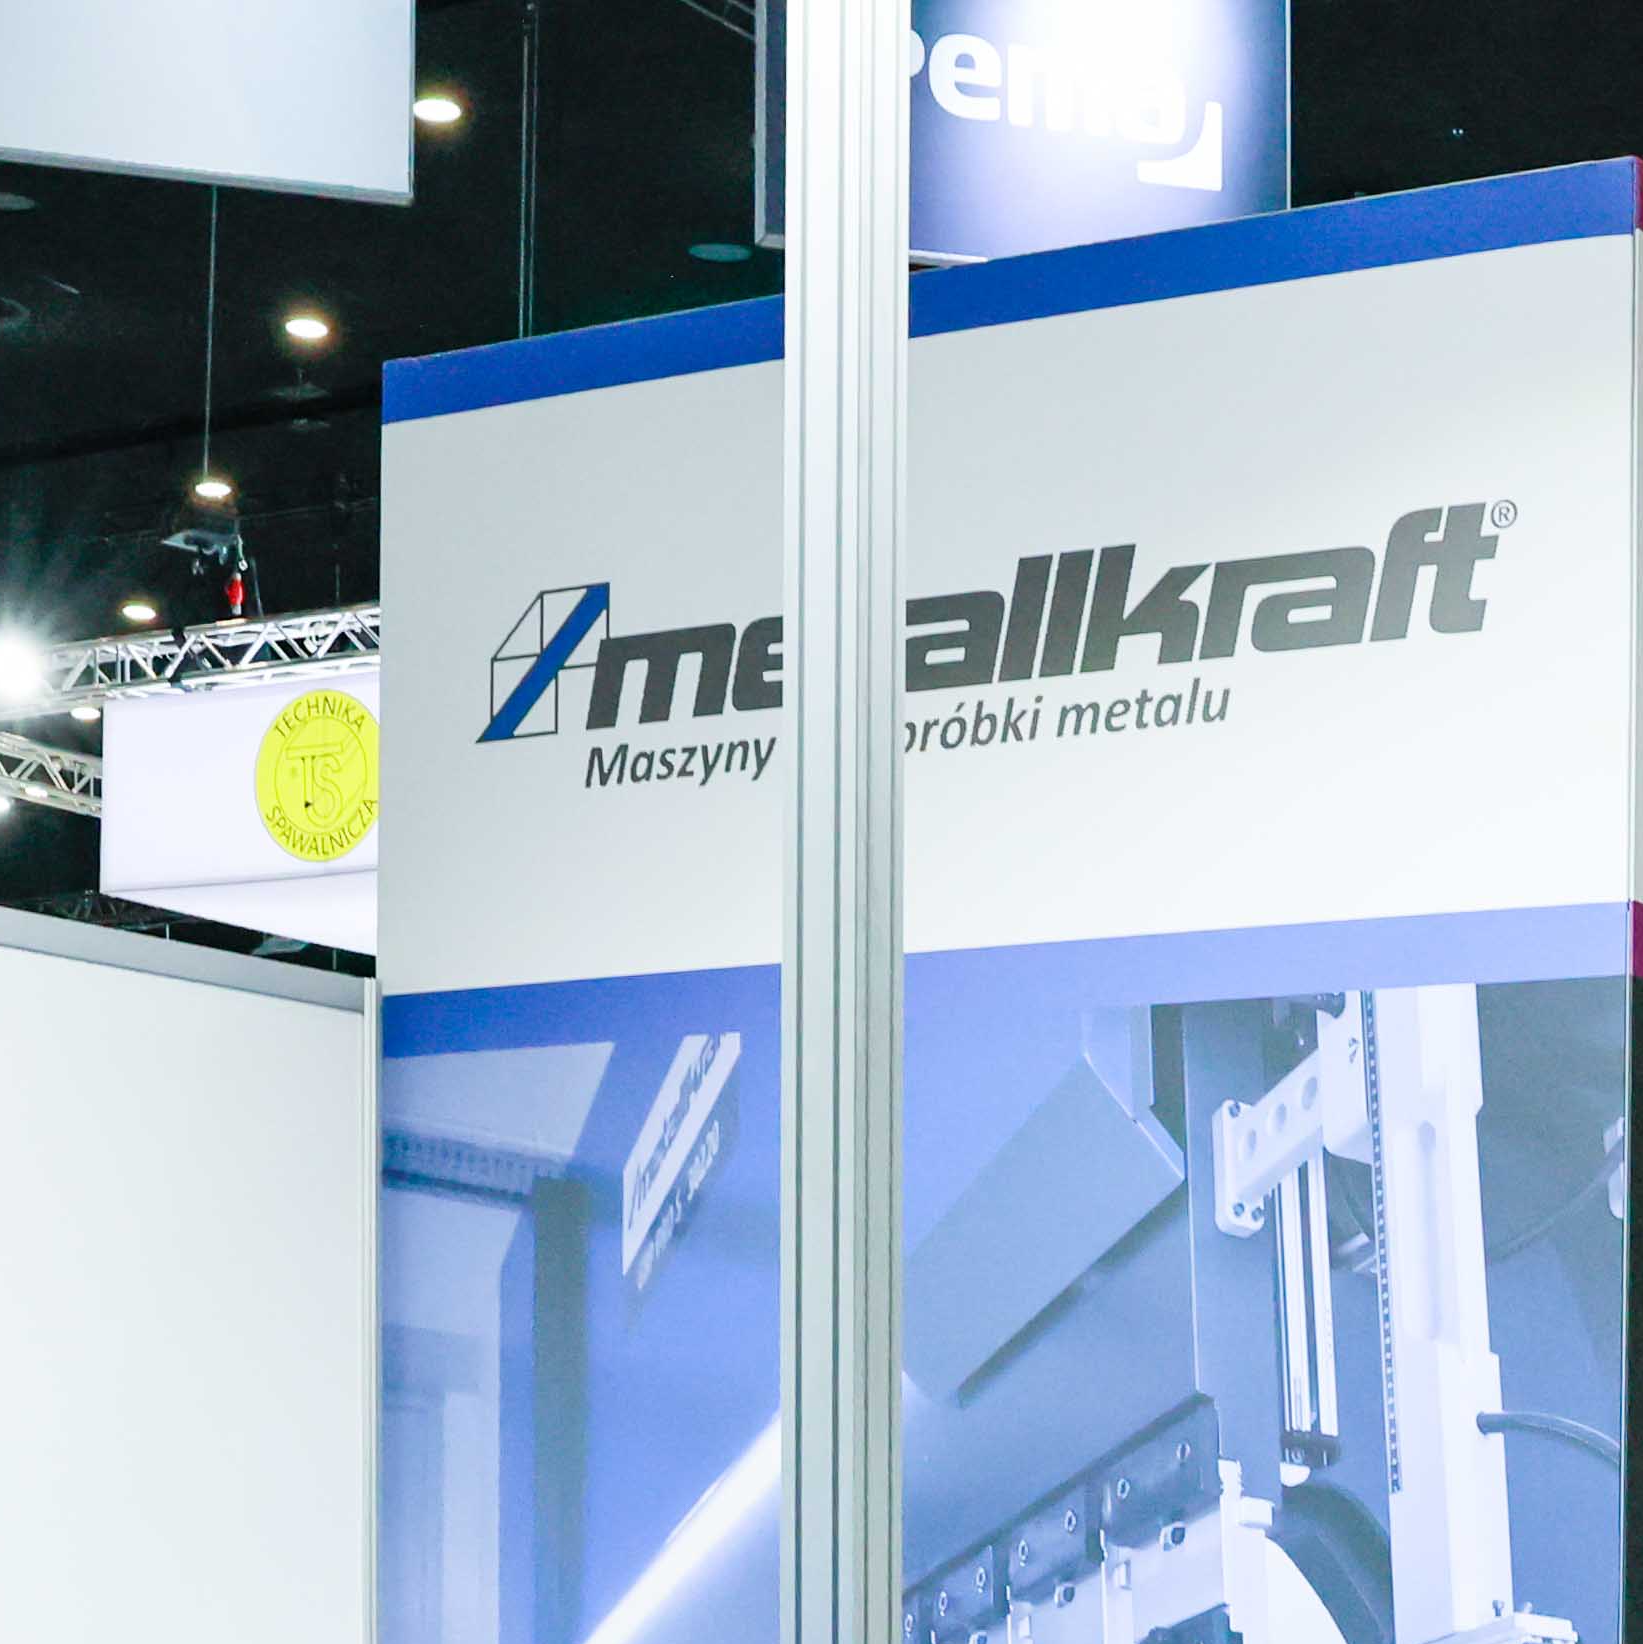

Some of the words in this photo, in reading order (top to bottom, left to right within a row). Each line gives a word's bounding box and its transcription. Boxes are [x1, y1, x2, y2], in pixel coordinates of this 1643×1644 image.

[586, 502, 1502, 729] meallkraft
[274, 695, 365, 739] TECHNIKA
[585, 736, 776, 789] Maszyny
[1056, 679, 1232, 740] metalu
[265, 798, 378, 857] SPAWALNICZA
